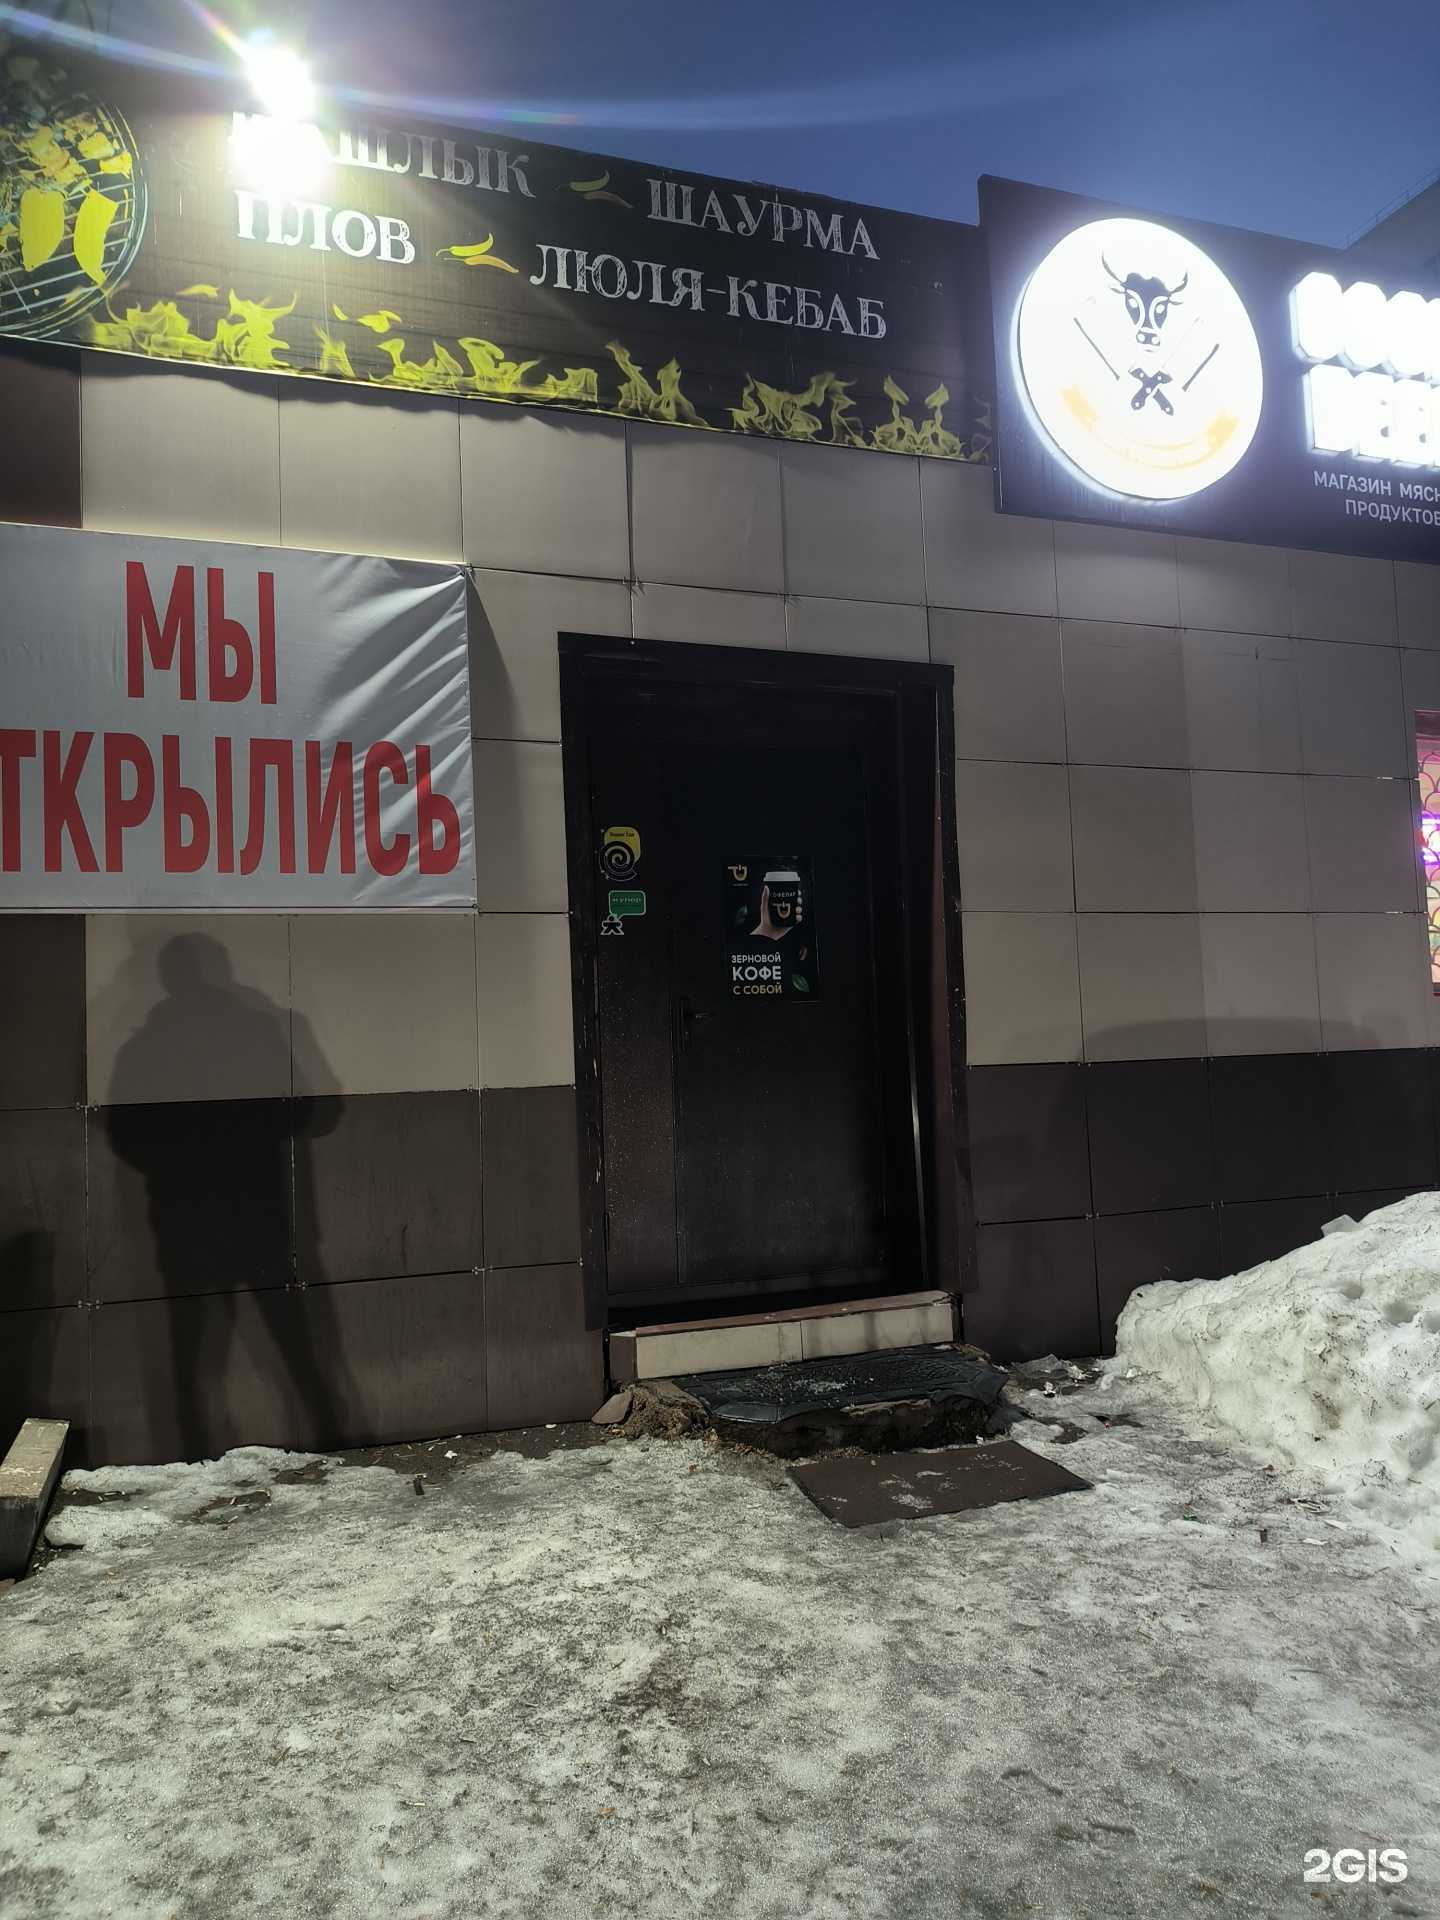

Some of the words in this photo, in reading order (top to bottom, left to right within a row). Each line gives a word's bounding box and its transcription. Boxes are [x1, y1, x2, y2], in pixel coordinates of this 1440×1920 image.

[228, 111, 536, 198] ШЛЫК
[646, 178, 881, 261] ШАУРМА
[233, 191, 416, 265] ПЛОВ
[529, 243, 887, 339] ЛЮЛЯ-КЕБАБ
[1313, 470, 1392, 497] МАГАЗИН
[126, 561, 277, 704] МЫ
[0, 729, 461, 876] ТКРЫЛИСЬ
[731, 951, 781, 963] ЗЕРНОВОЙ
[732, 966, 781, 981] КОФЕ
[733, 985, 741, 995] С
[743, 981, 782, 995] СОБОЙ
